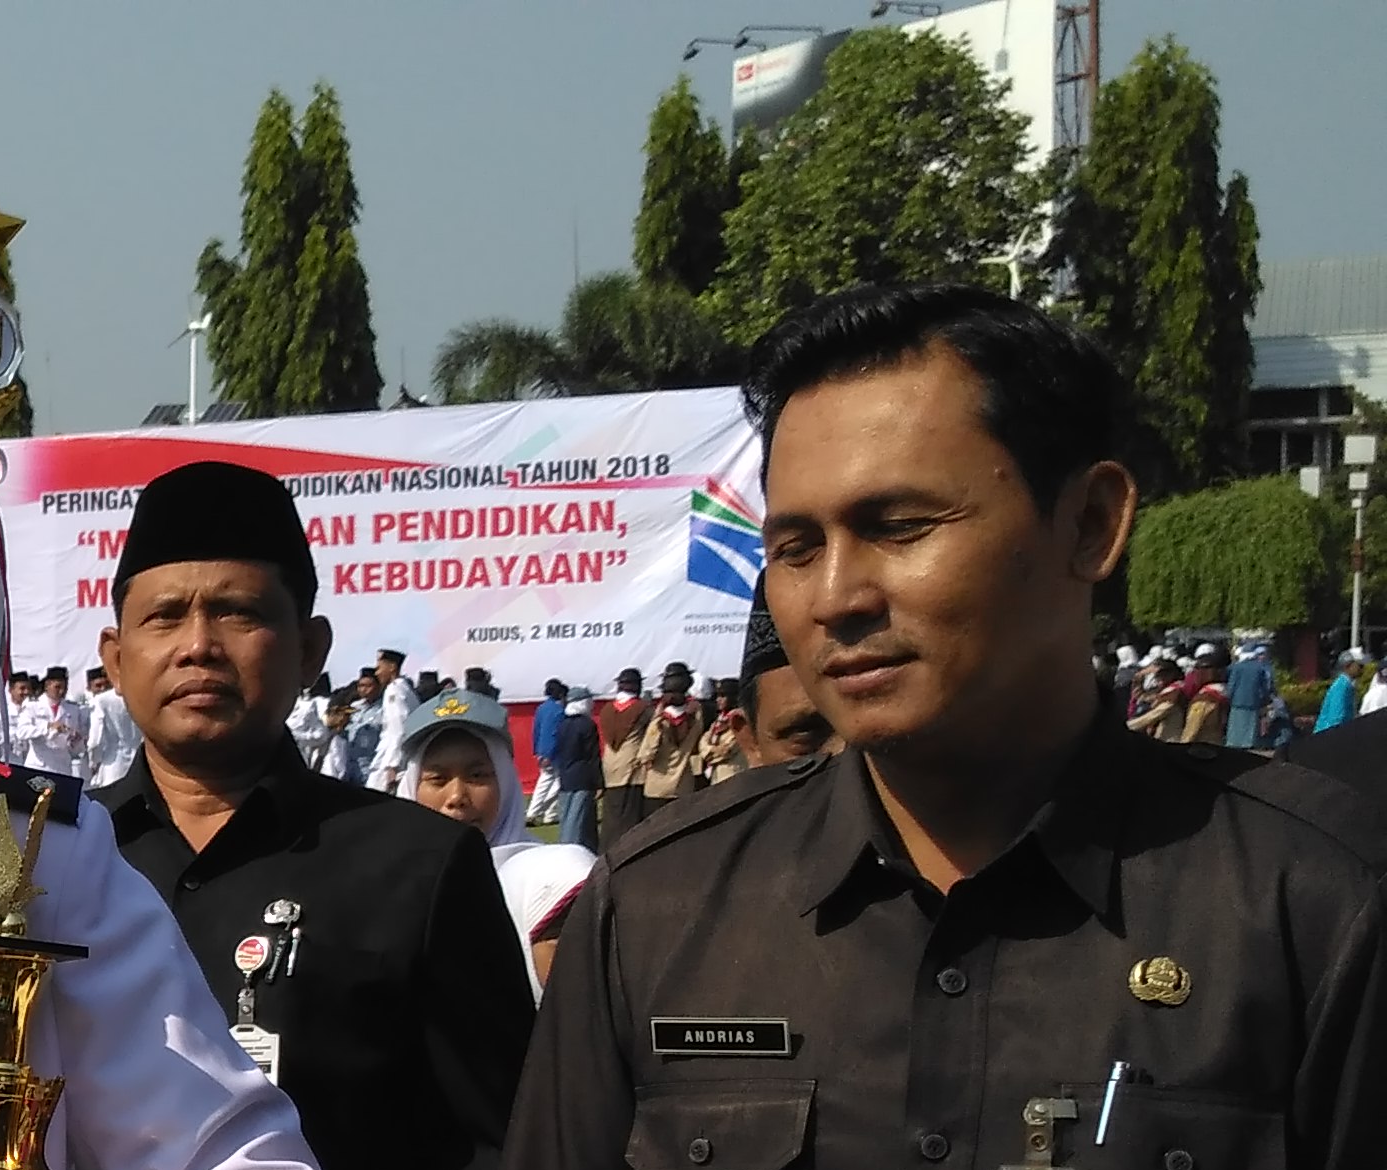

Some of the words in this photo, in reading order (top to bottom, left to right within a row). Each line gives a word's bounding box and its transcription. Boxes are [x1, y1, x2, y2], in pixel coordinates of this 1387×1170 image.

[391, 465, 509, 492] NASIONAL
[516, 458, 598, 485] TAHUN
[606, 453, 671, 478] 2018
[371, 500, 627, 544] PENDIDIKAN,
[467, 625, 525, 644] KUDUS,
[530, 625, 541, 640] 2
[547, 623, 576, 639] MEI
[581, 621, 625, 638] 2018
[684, 1030, 755, 1043] ANDRIAS
